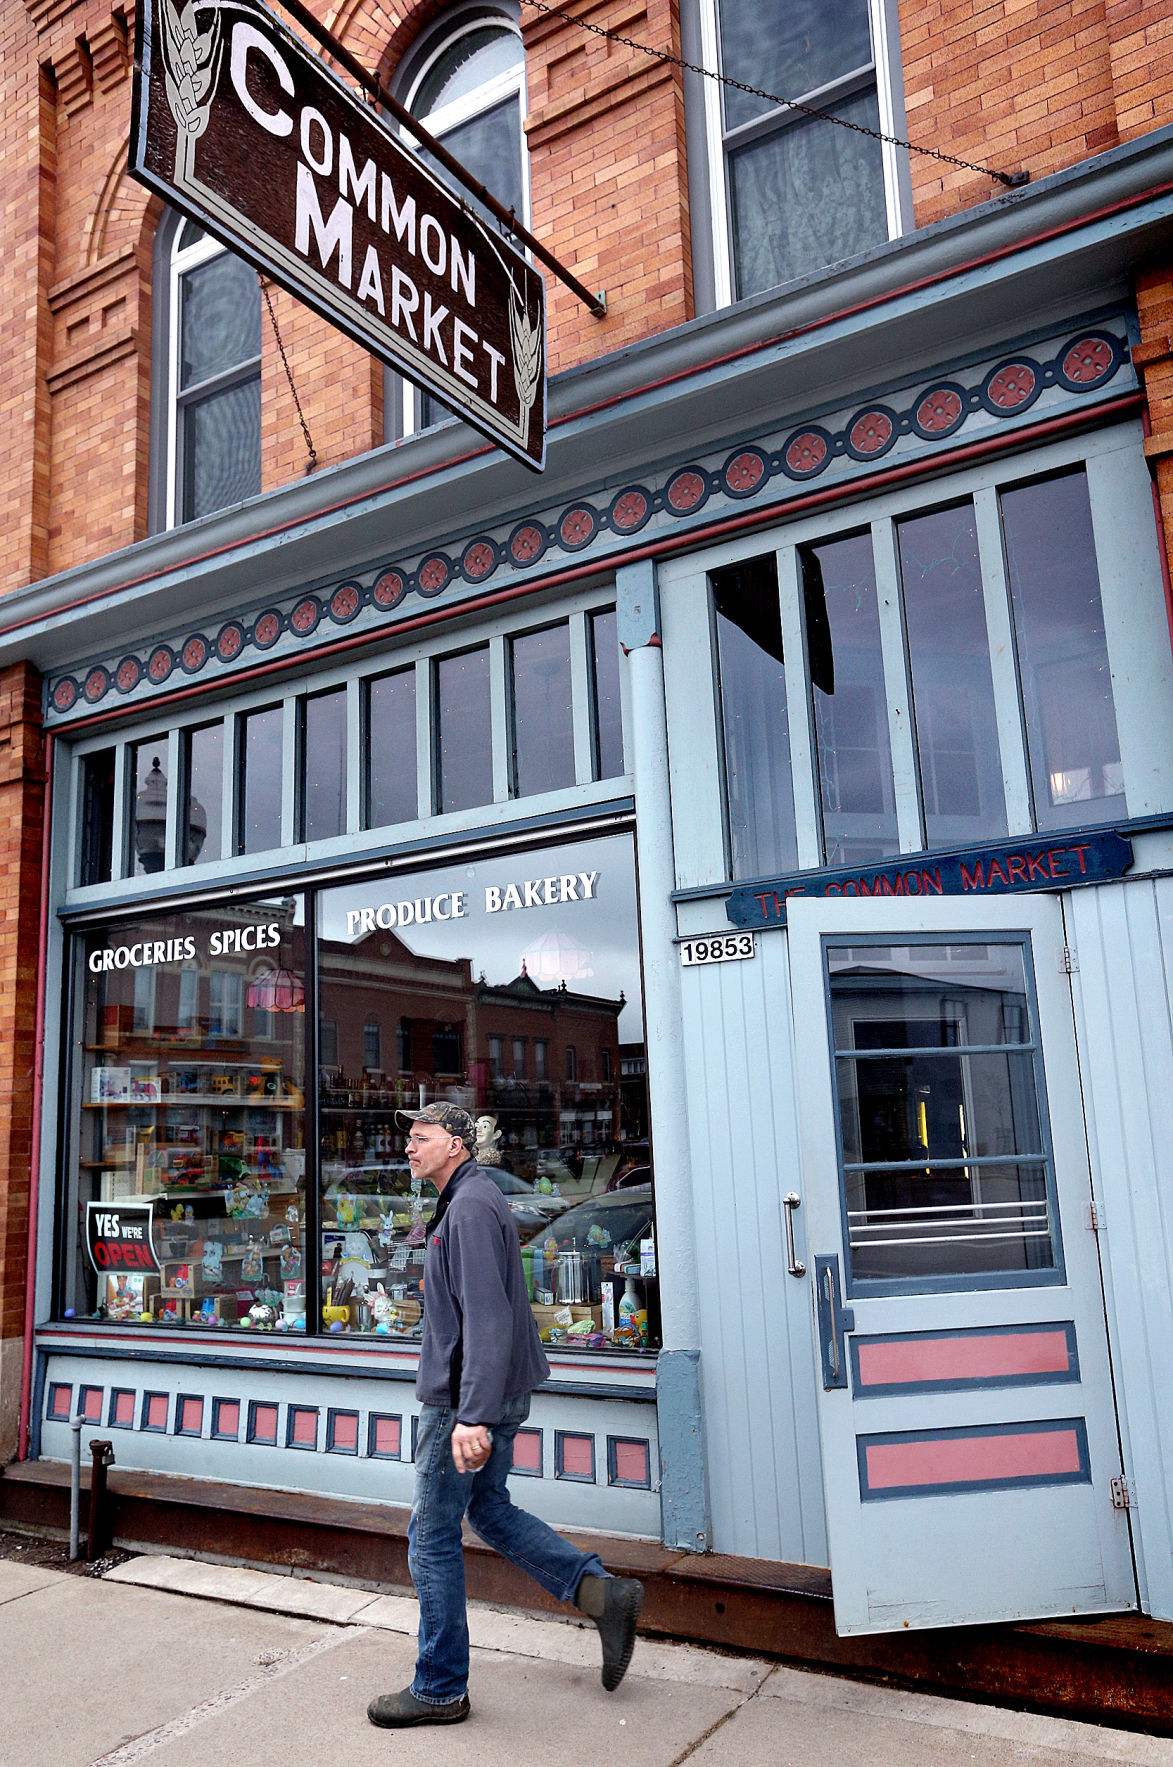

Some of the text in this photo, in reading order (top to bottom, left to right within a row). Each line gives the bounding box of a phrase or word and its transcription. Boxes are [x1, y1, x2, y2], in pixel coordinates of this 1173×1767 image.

[230, 21, 476, 307] COMMON
[294, 160, 506, 404] MARKET
[959, 843, 1092, 891] MARKET
[346, 870, 598, 935] PRODUCE BAKERY
[88, 922, 281, 973] GROCERIES SPICES
[683, 936, 752, 962] 19853
[95, 1213, 143, 1240] YES WE'RE
[94, 1241, 155, 1268] OPEN
